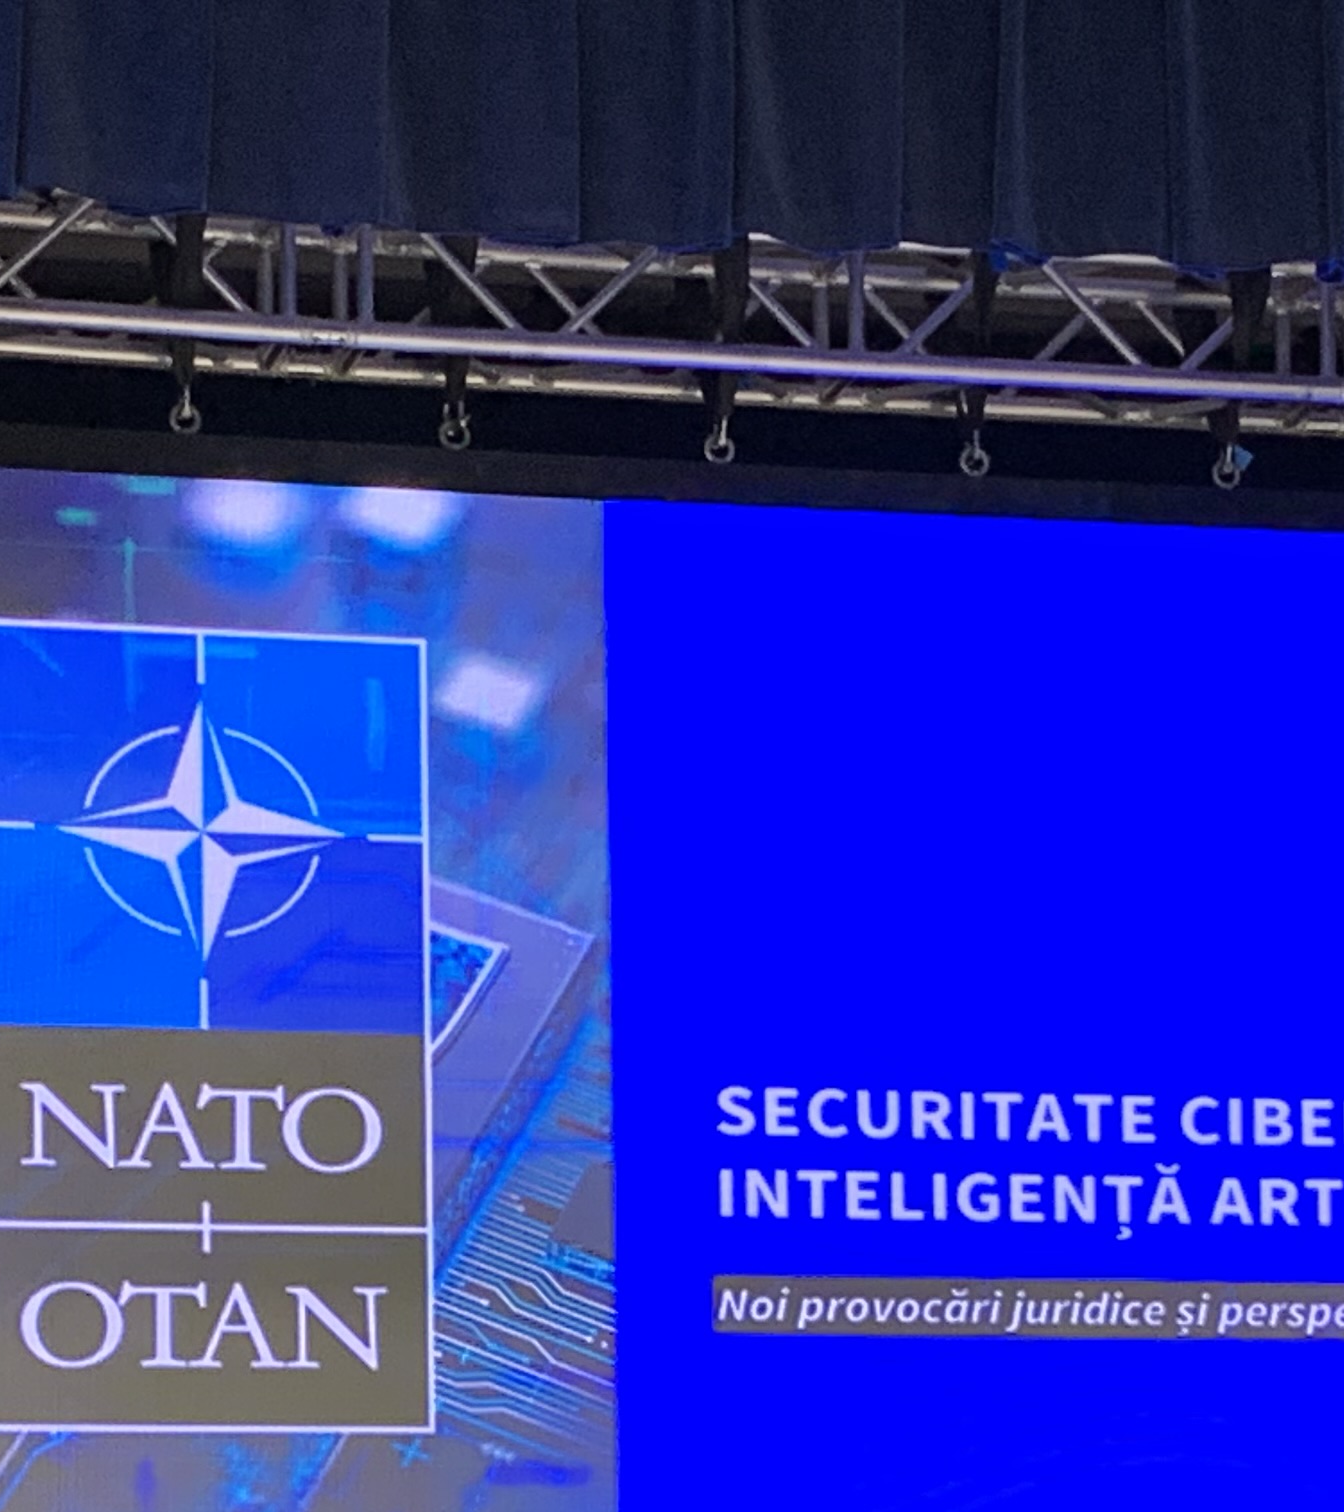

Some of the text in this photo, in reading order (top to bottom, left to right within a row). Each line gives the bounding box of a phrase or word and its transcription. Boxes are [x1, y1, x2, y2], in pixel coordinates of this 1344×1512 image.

[19, 1081, 382, 1173] NATO
[716, 1085, 1156, 1144] SECURITATE
[20, 1279, 388, 1371] OTAN
[718, 1286, 790, 1322] Noi
[797, 1289, 1003, 1329] provocări
[1006, 1290, 1165, 1332] juridice
